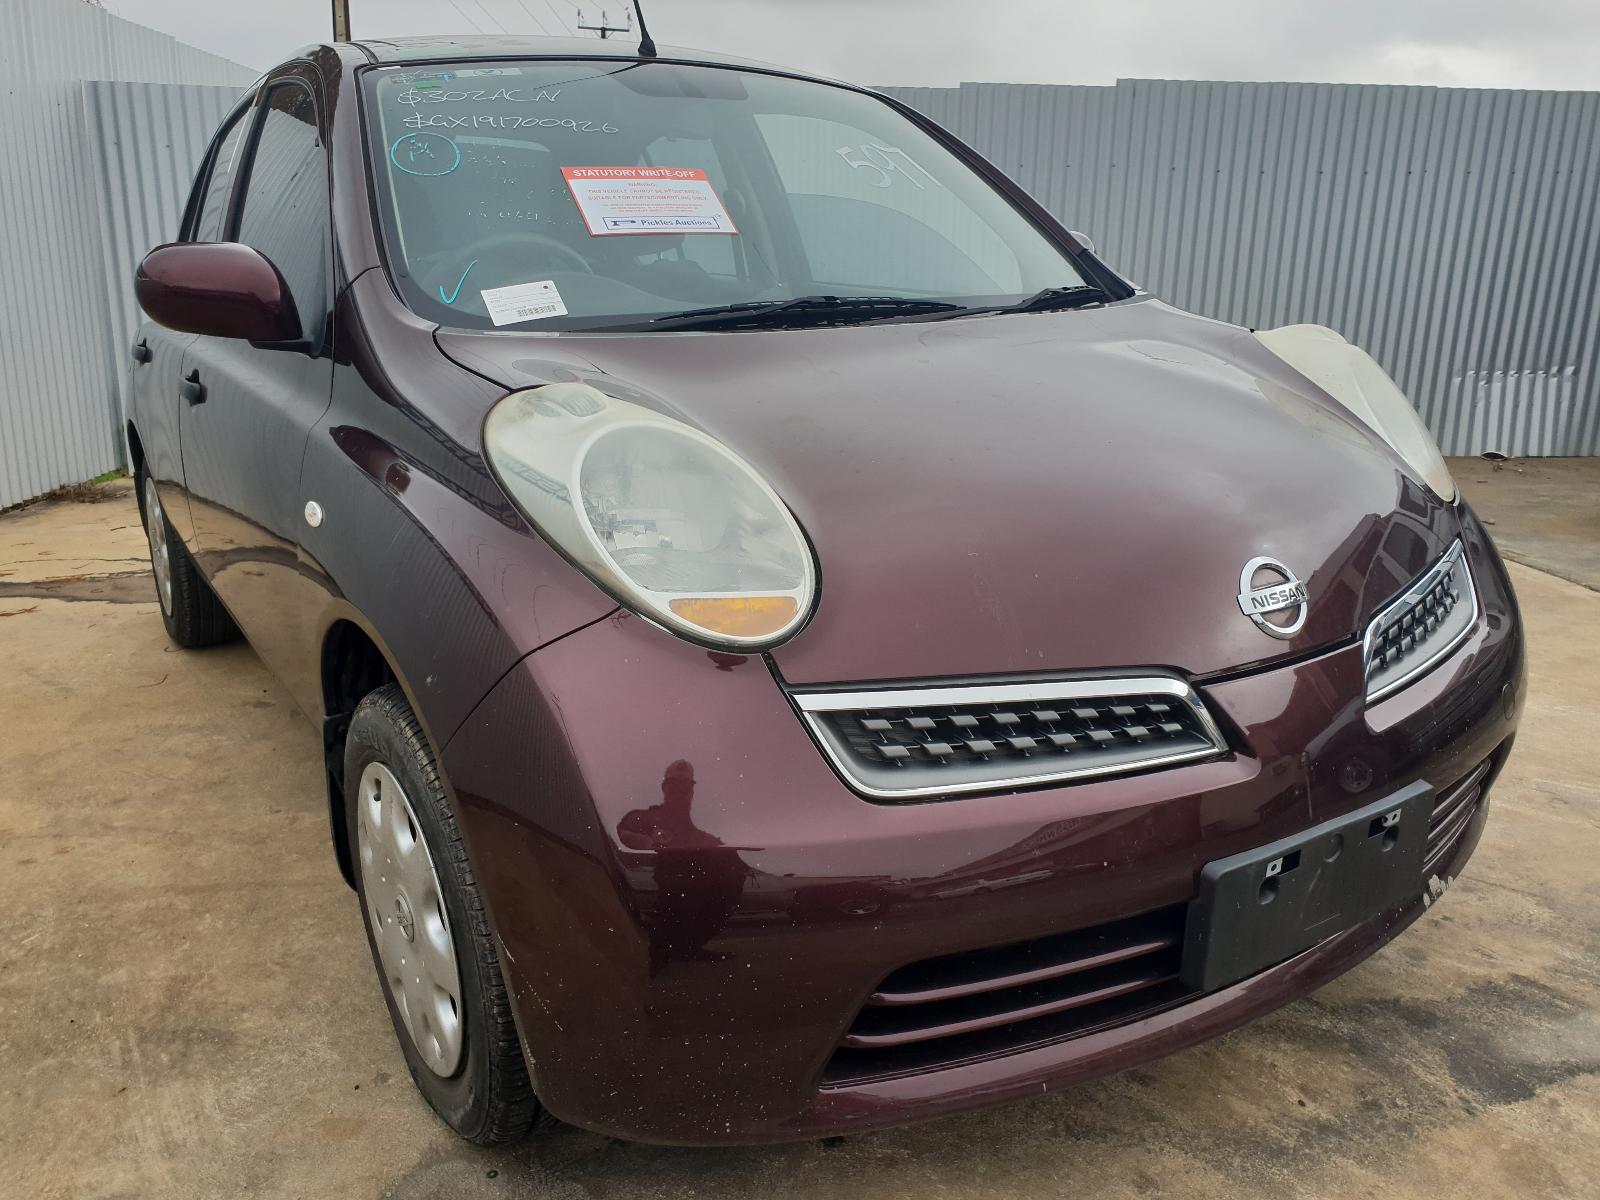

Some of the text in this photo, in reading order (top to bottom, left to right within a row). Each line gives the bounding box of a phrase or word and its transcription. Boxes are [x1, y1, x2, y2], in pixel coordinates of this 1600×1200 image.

[573, 169, 696, 178] STATUTORY WRITE-OFF
[1251, 585, 1306, 610] NISSAN
